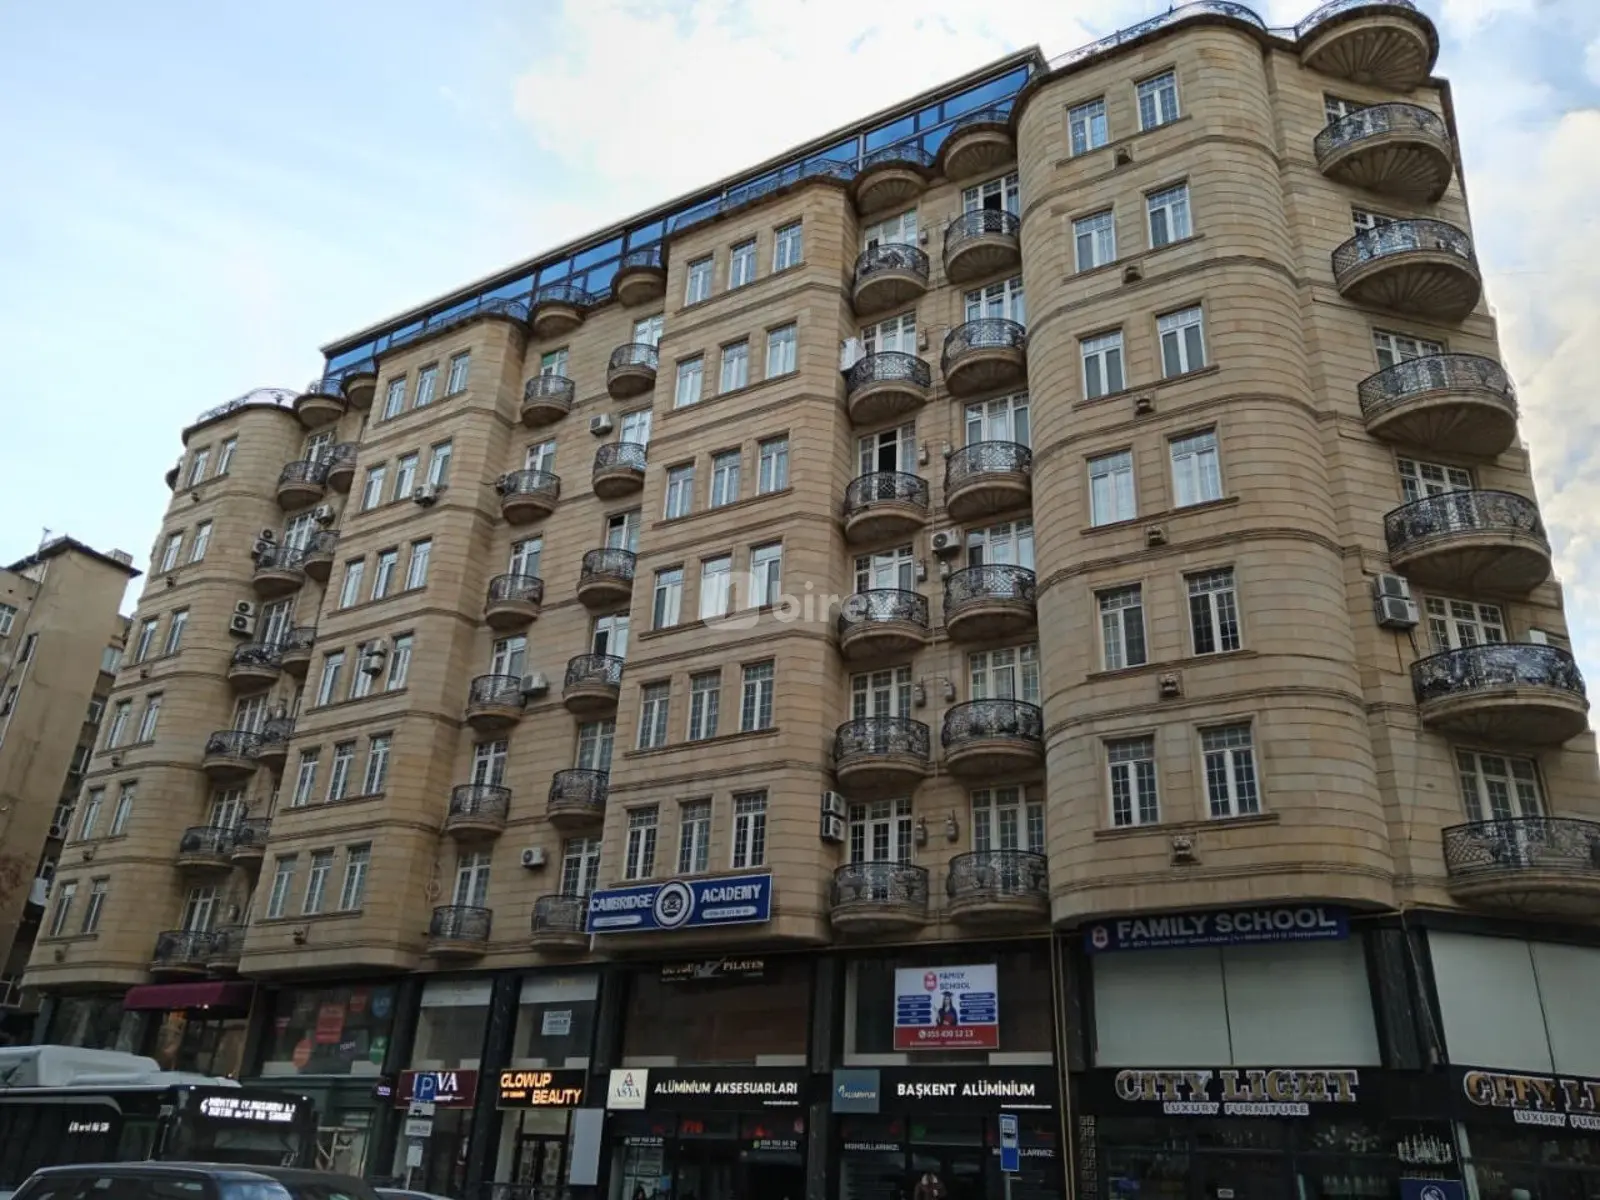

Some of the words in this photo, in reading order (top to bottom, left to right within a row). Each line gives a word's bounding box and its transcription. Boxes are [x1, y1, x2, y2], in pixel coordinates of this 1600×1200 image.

[590, 892, 653, 912] CAMBRIDGE
[701, 883, 762, 904] ACADEMY
[1116, 915, 1208, 940] FAMILY
[1215, 907, 1338, 933] SCHOOL
[939, 971, 966, 979] FAMILY
[939, 982, 970, 990] SCHOOL
[420, 1077, 433, 1097] P
[501, 1072, 552, 1088] GLOWUP
[714, 1082, 798, 1094] AKSESUARLARI
[1115, 1069, 1213, 1101] CITY
[1219, 1069, 1359, 1102] LIGHT
[532, 1089, 581, 1104] BEAUTY
[897, 1083, 957, 1099] BAŞKENT
[1463, 1070, 1557, 1111] CITY
[1163, 1102, 1219, 1114] LUXURY
[1223, 1102, 1309, 1115] FURNITURE
[1513, 1110, 1567, 1127] LUXURY
